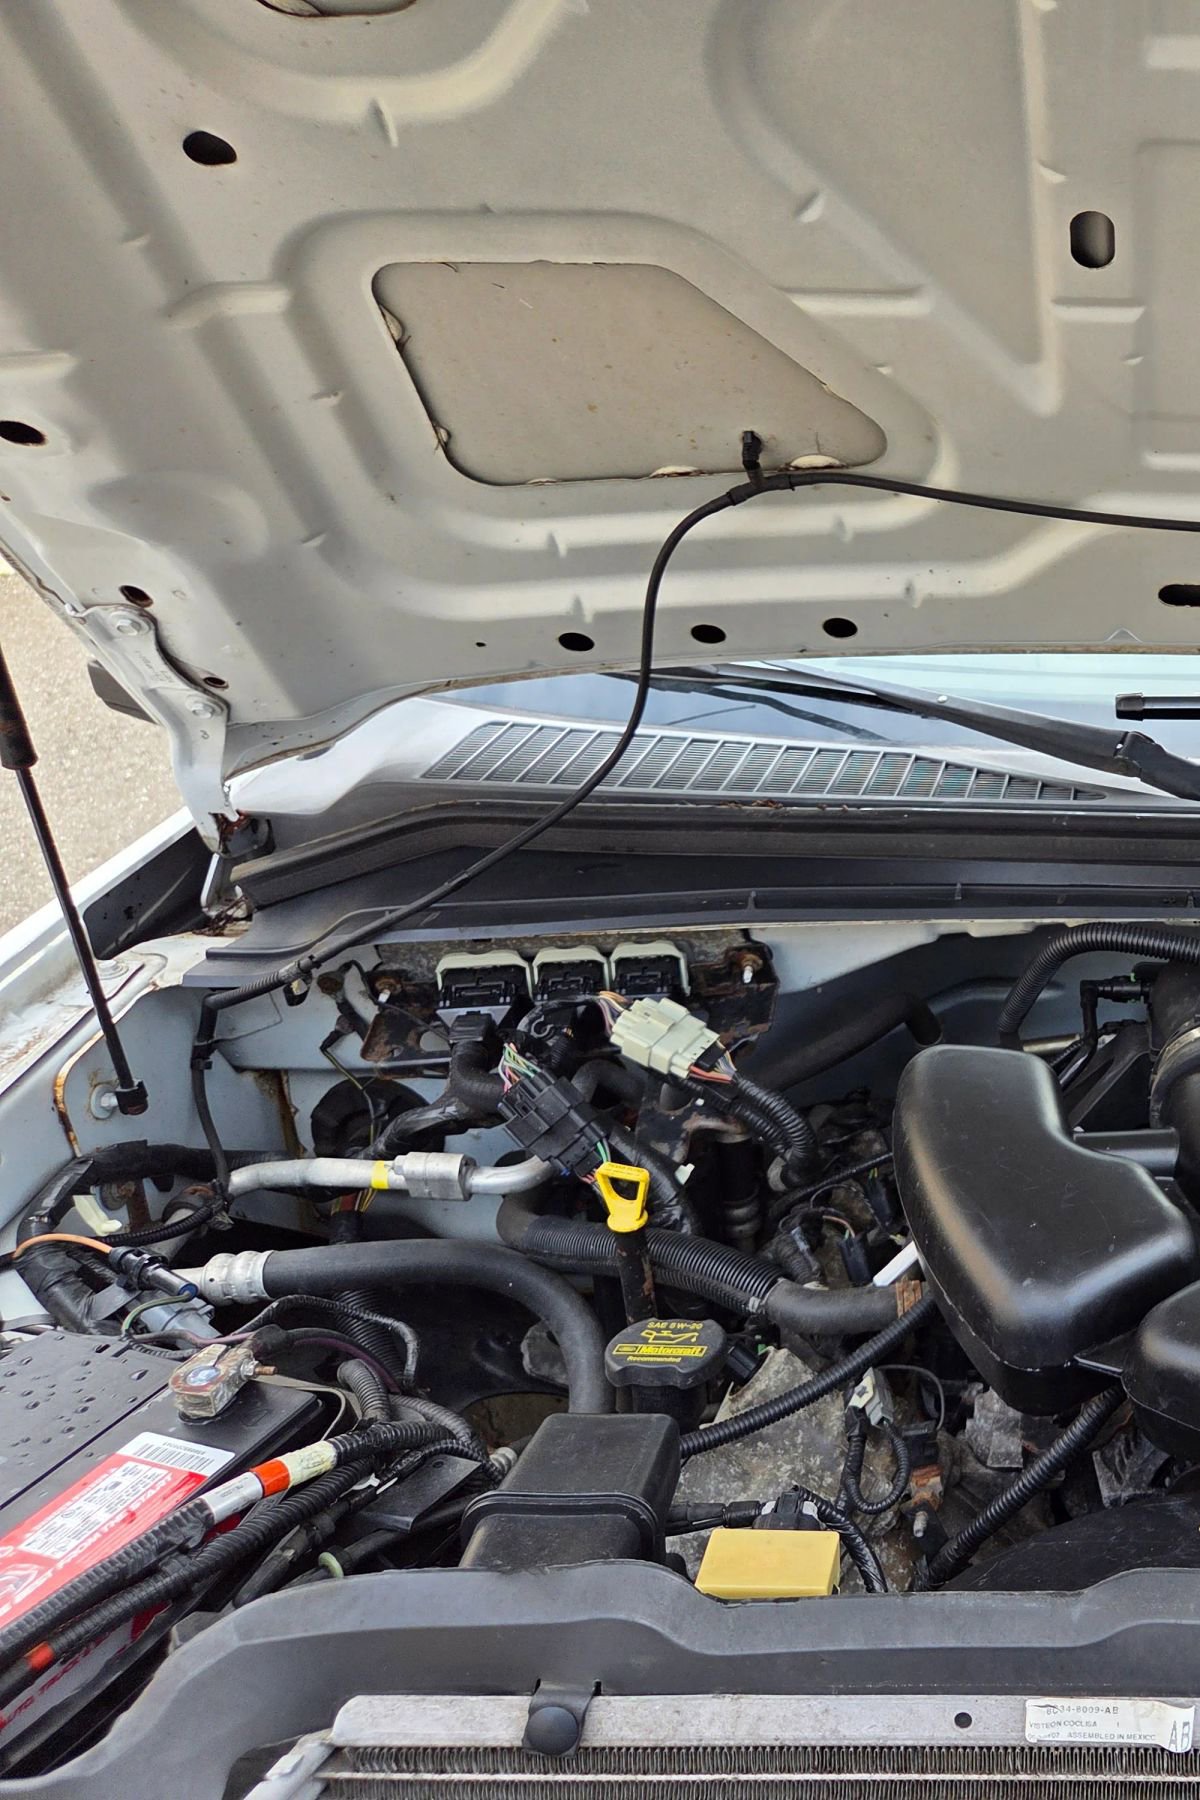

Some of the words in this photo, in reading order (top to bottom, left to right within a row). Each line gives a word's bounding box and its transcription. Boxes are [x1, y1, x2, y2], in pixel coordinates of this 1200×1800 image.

[647, 1321, 666, 1329] SAE
[670, 1321, 704, 1330] 5W-20
[640, 1344, 701, 1357] Motorcraft
[627, 1355, 682, 1363] Recommended
[1067, 1731, 1115, 1740] ASSEMBLED
[1116, 1732, 1125, 1740] IN
[1168, 1720, 1191, 1752] AB
